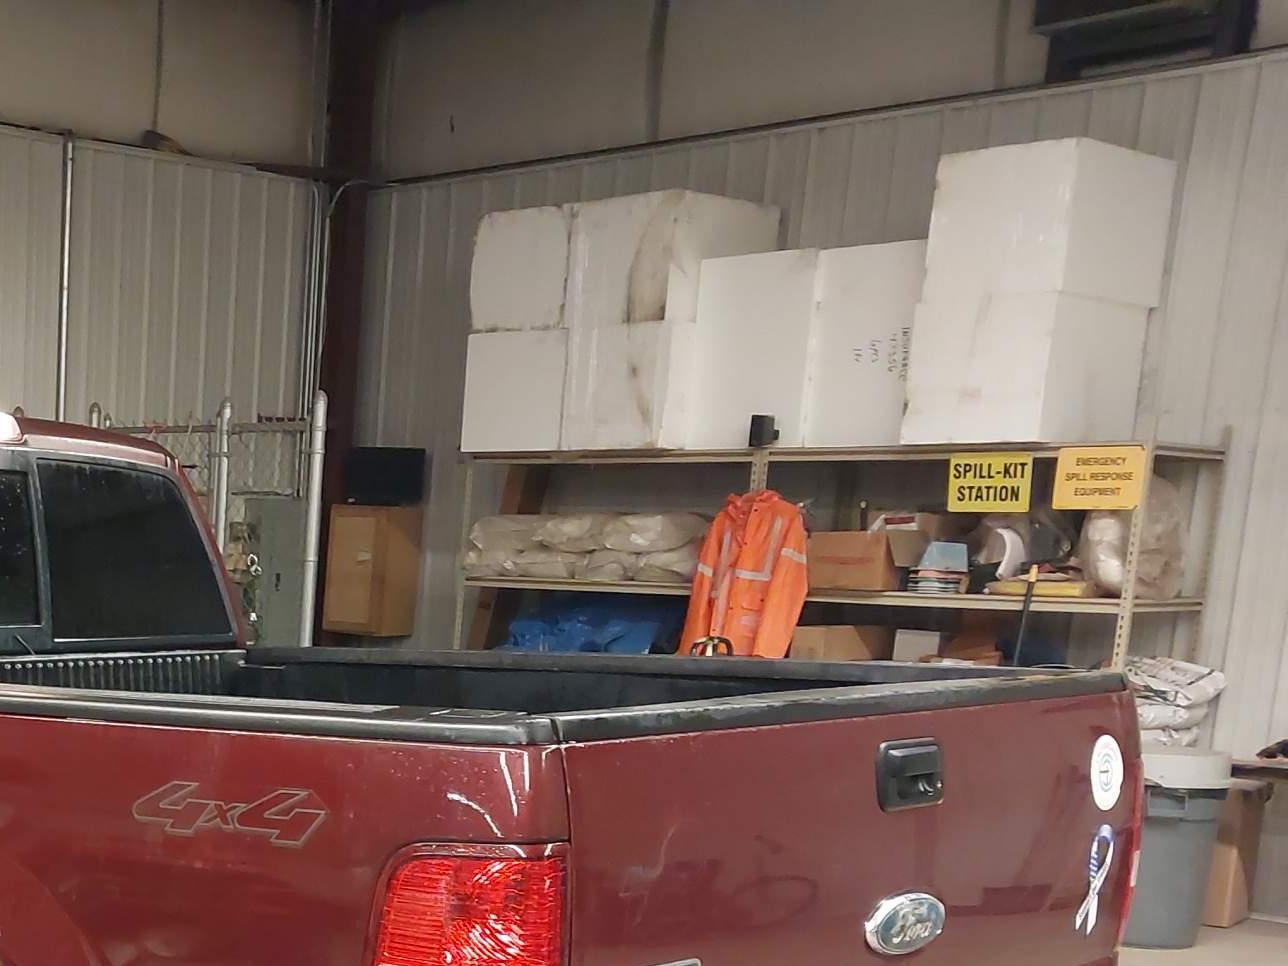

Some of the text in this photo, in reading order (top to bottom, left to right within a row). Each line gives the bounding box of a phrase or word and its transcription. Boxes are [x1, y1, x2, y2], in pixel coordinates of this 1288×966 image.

[1075, 456, 1128, 467] EMERGENCY
[952, 461, 1028, 480] SPILL-KIT
[1065, 471, 1135, 482] SPILL RESPONSE
[956, 484, 1021, 503] STATION
[1073, 487, 1122, 497] EQUIPMENT
[132, 780, 330, 849] 4x4
